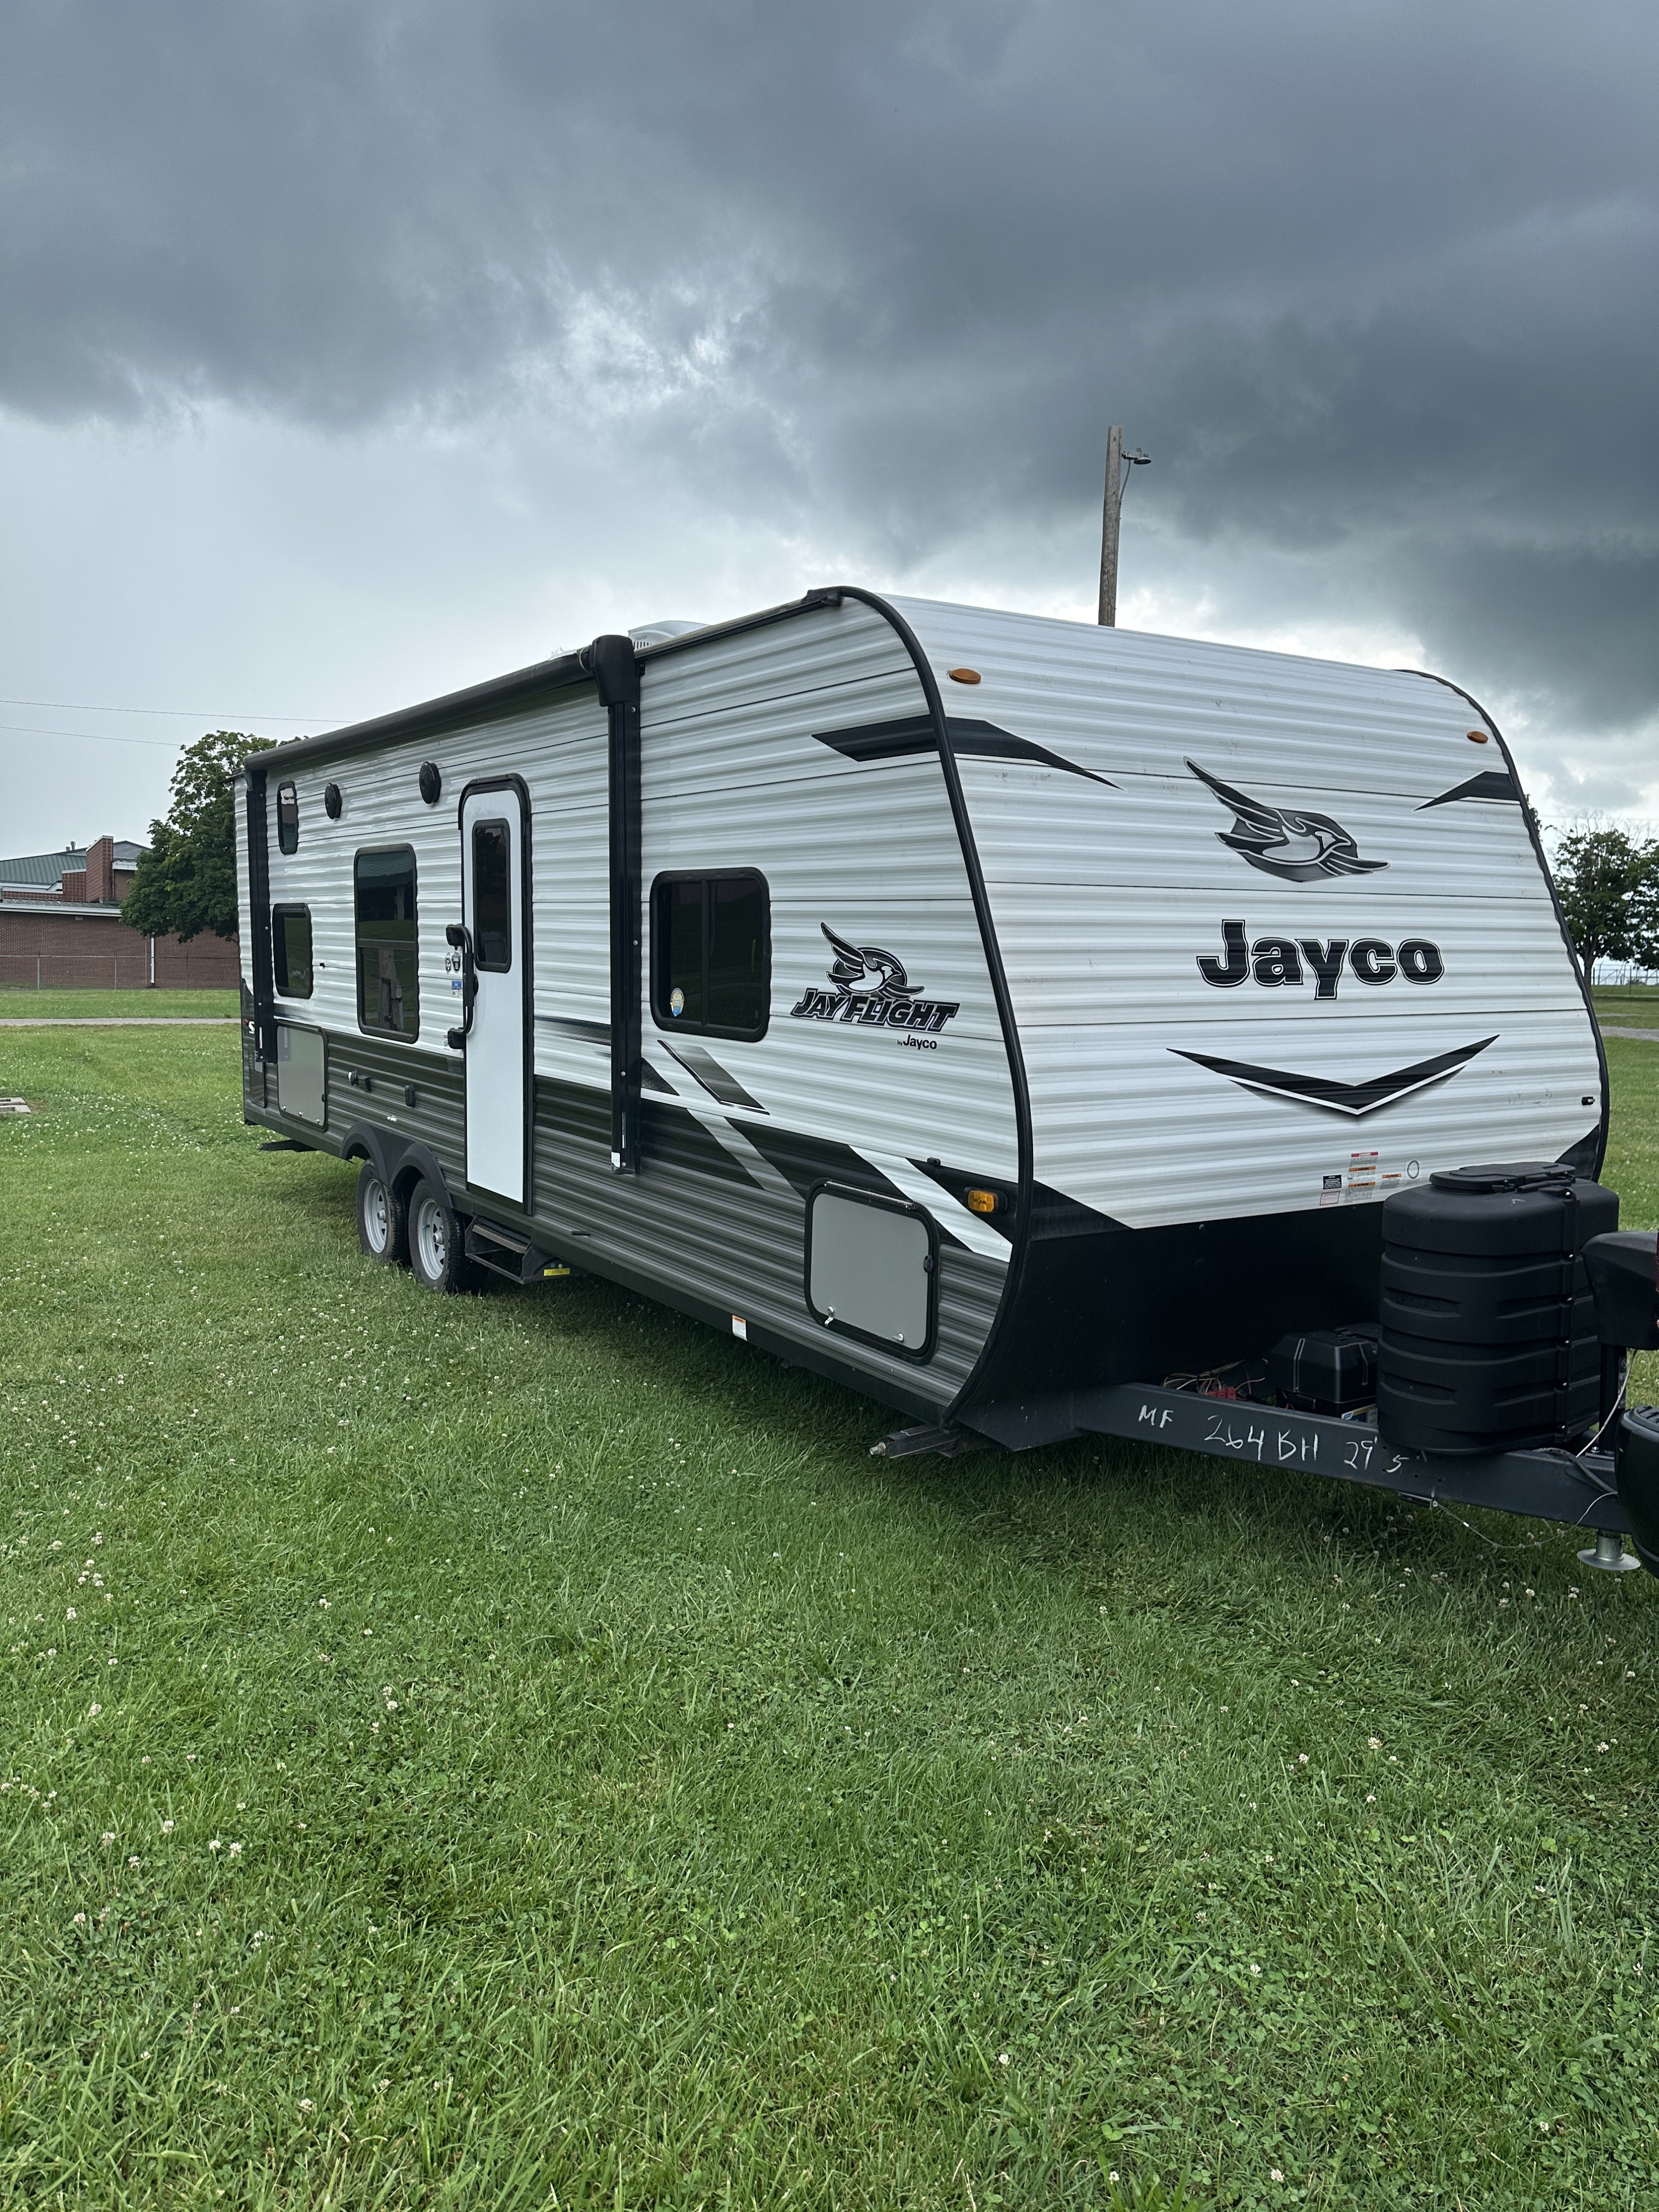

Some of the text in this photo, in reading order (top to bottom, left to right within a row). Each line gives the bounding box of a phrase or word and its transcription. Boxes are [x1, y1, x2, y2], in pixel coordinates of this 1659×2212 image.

[1196, 919, 1444, 1000] Jayco
[790, 988, 960, 1032] JAY FLIGHT
[903, 1034, 937, 1050] Jayco
[1138, 1405, 1174, 1428] MF
